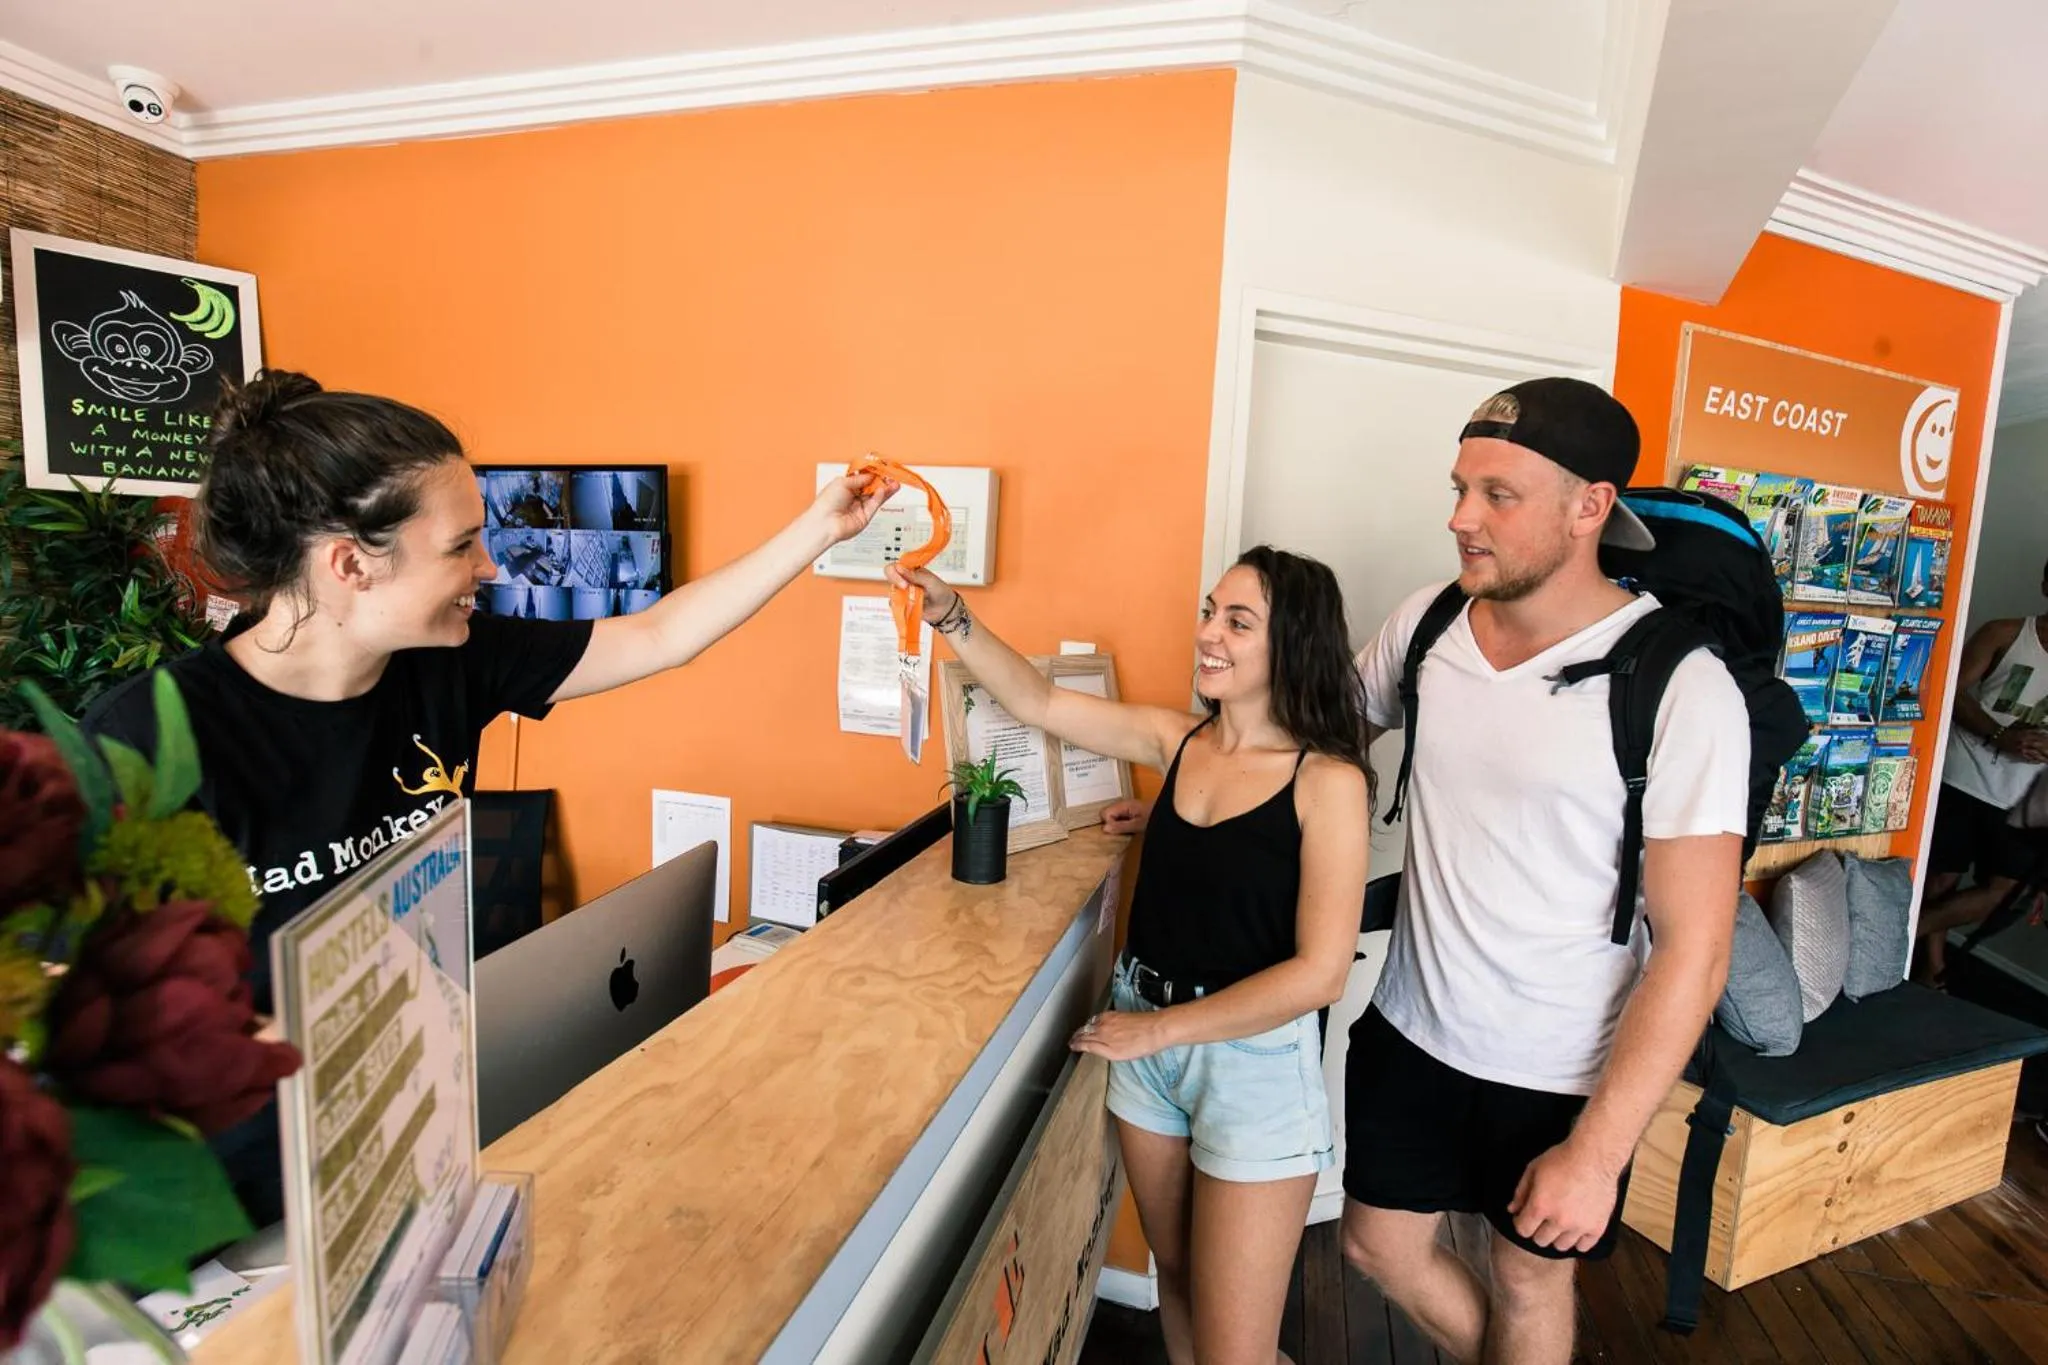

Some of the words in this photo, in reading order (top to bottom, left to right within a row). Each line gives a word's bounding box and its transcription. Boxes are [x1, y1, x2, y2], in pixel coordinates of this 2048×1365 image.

[71, 398, 149, 422] SMILE
[164, 410, 212, 428] LIKE
[1704, 386, 1770, 422] EAST
[1773, 400, 1848, 437] COAST
[70, 441, 127, 457] WITH
[136, 445, 152, 458] A
[91, 423, 108, 436] A
[132, 428, 207, 445] MONKEY
[329, 795, 444, 875] Monkey
[393, 832, 461, 922] AUSTRALIA
